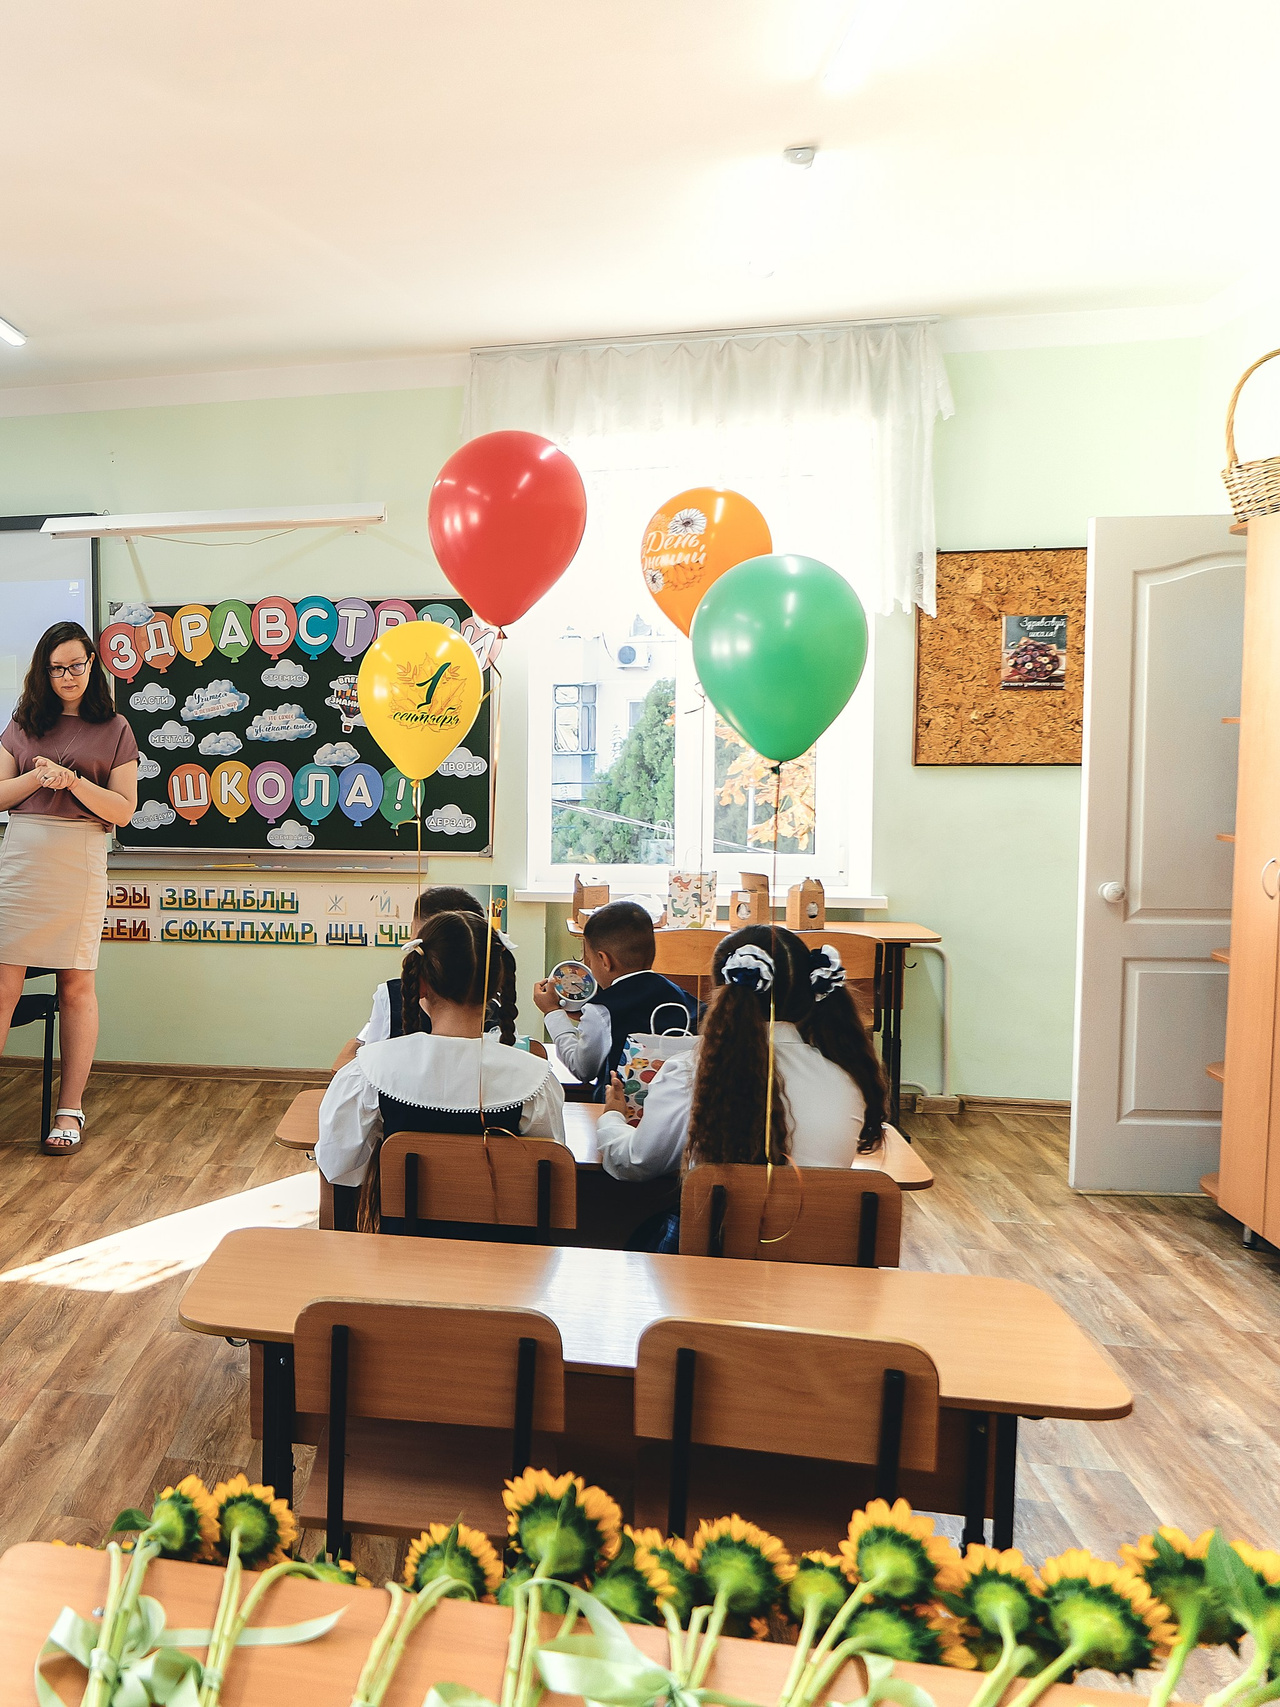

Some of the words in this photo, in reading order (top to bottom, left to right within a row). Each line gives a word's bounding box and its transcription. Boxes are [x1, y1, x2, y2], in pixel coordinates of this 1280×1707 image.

[646, 530, 700, 554] День
[263, 674, 308, 682] СТРЕМИСЬ
[338, 676, 359, 684] ВПЕ
[416, 662, 452, 710] 1
[133, 696, 169, 705] РАСТИ
[393, 707, 460, 728] сентября
[151, 733, 191, 744] МЕЧТАЙ
[441, 761, 482, 771] ТВОРИ
[172, 771, 407, 811] ШКОЛА!
[133, 811, 174, 824] ИССЛЕДУЙ
[428, 816, 473, 828] ДЕРЗАЙ
